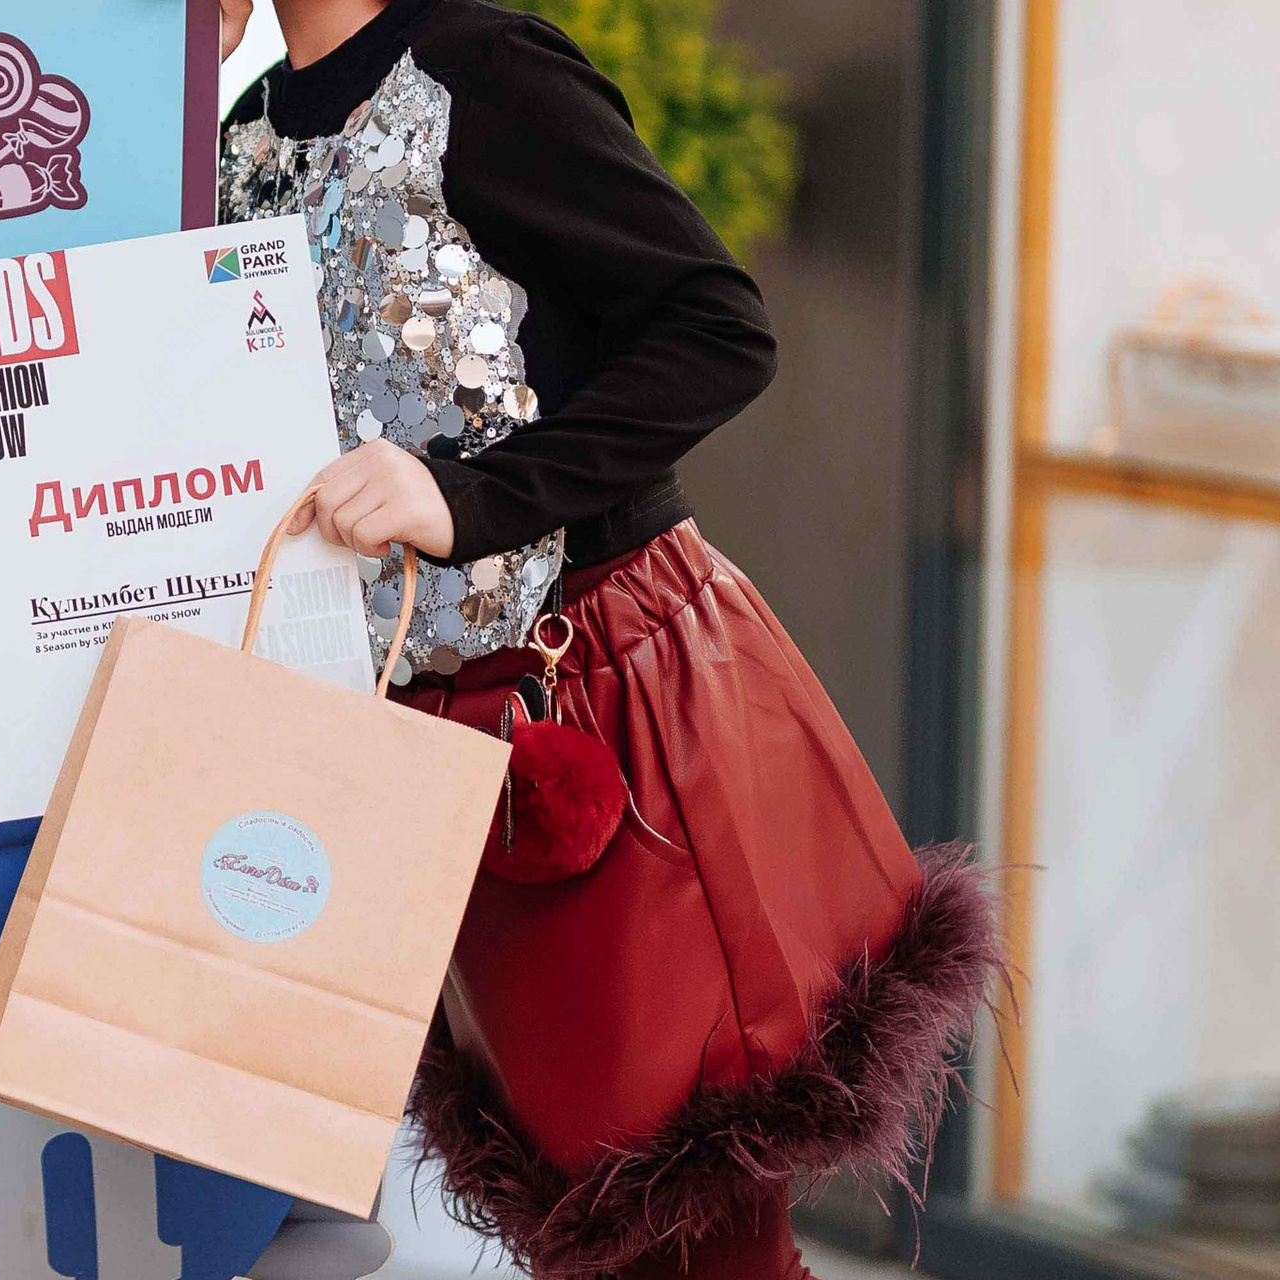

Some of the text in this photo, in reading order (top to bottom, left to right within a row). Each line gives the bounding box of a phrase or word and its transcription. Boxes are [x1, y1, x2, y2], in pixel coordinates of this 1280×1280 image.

[240, 239, 285, 255] GRAND
[242, 251, 287, 270] PARK
[244, 266, 289, 280] SHYMKENT
[246, 332, 285, 353] KIDS
[28, 458, 265, 538] Диплом
[106, 506, 214, 538] ВЫДАН МОДЕЛИ
[165, 570, 272, 599] Шұғыл
[35, 631, 49, 641] За
[50, 626, 91, 640] участие
[171, 608, 201, 620] SHOW
[35, 645, 42, 654] 8
[43, 642, 77, 653] Season
[79, 638, 91, 649] by
